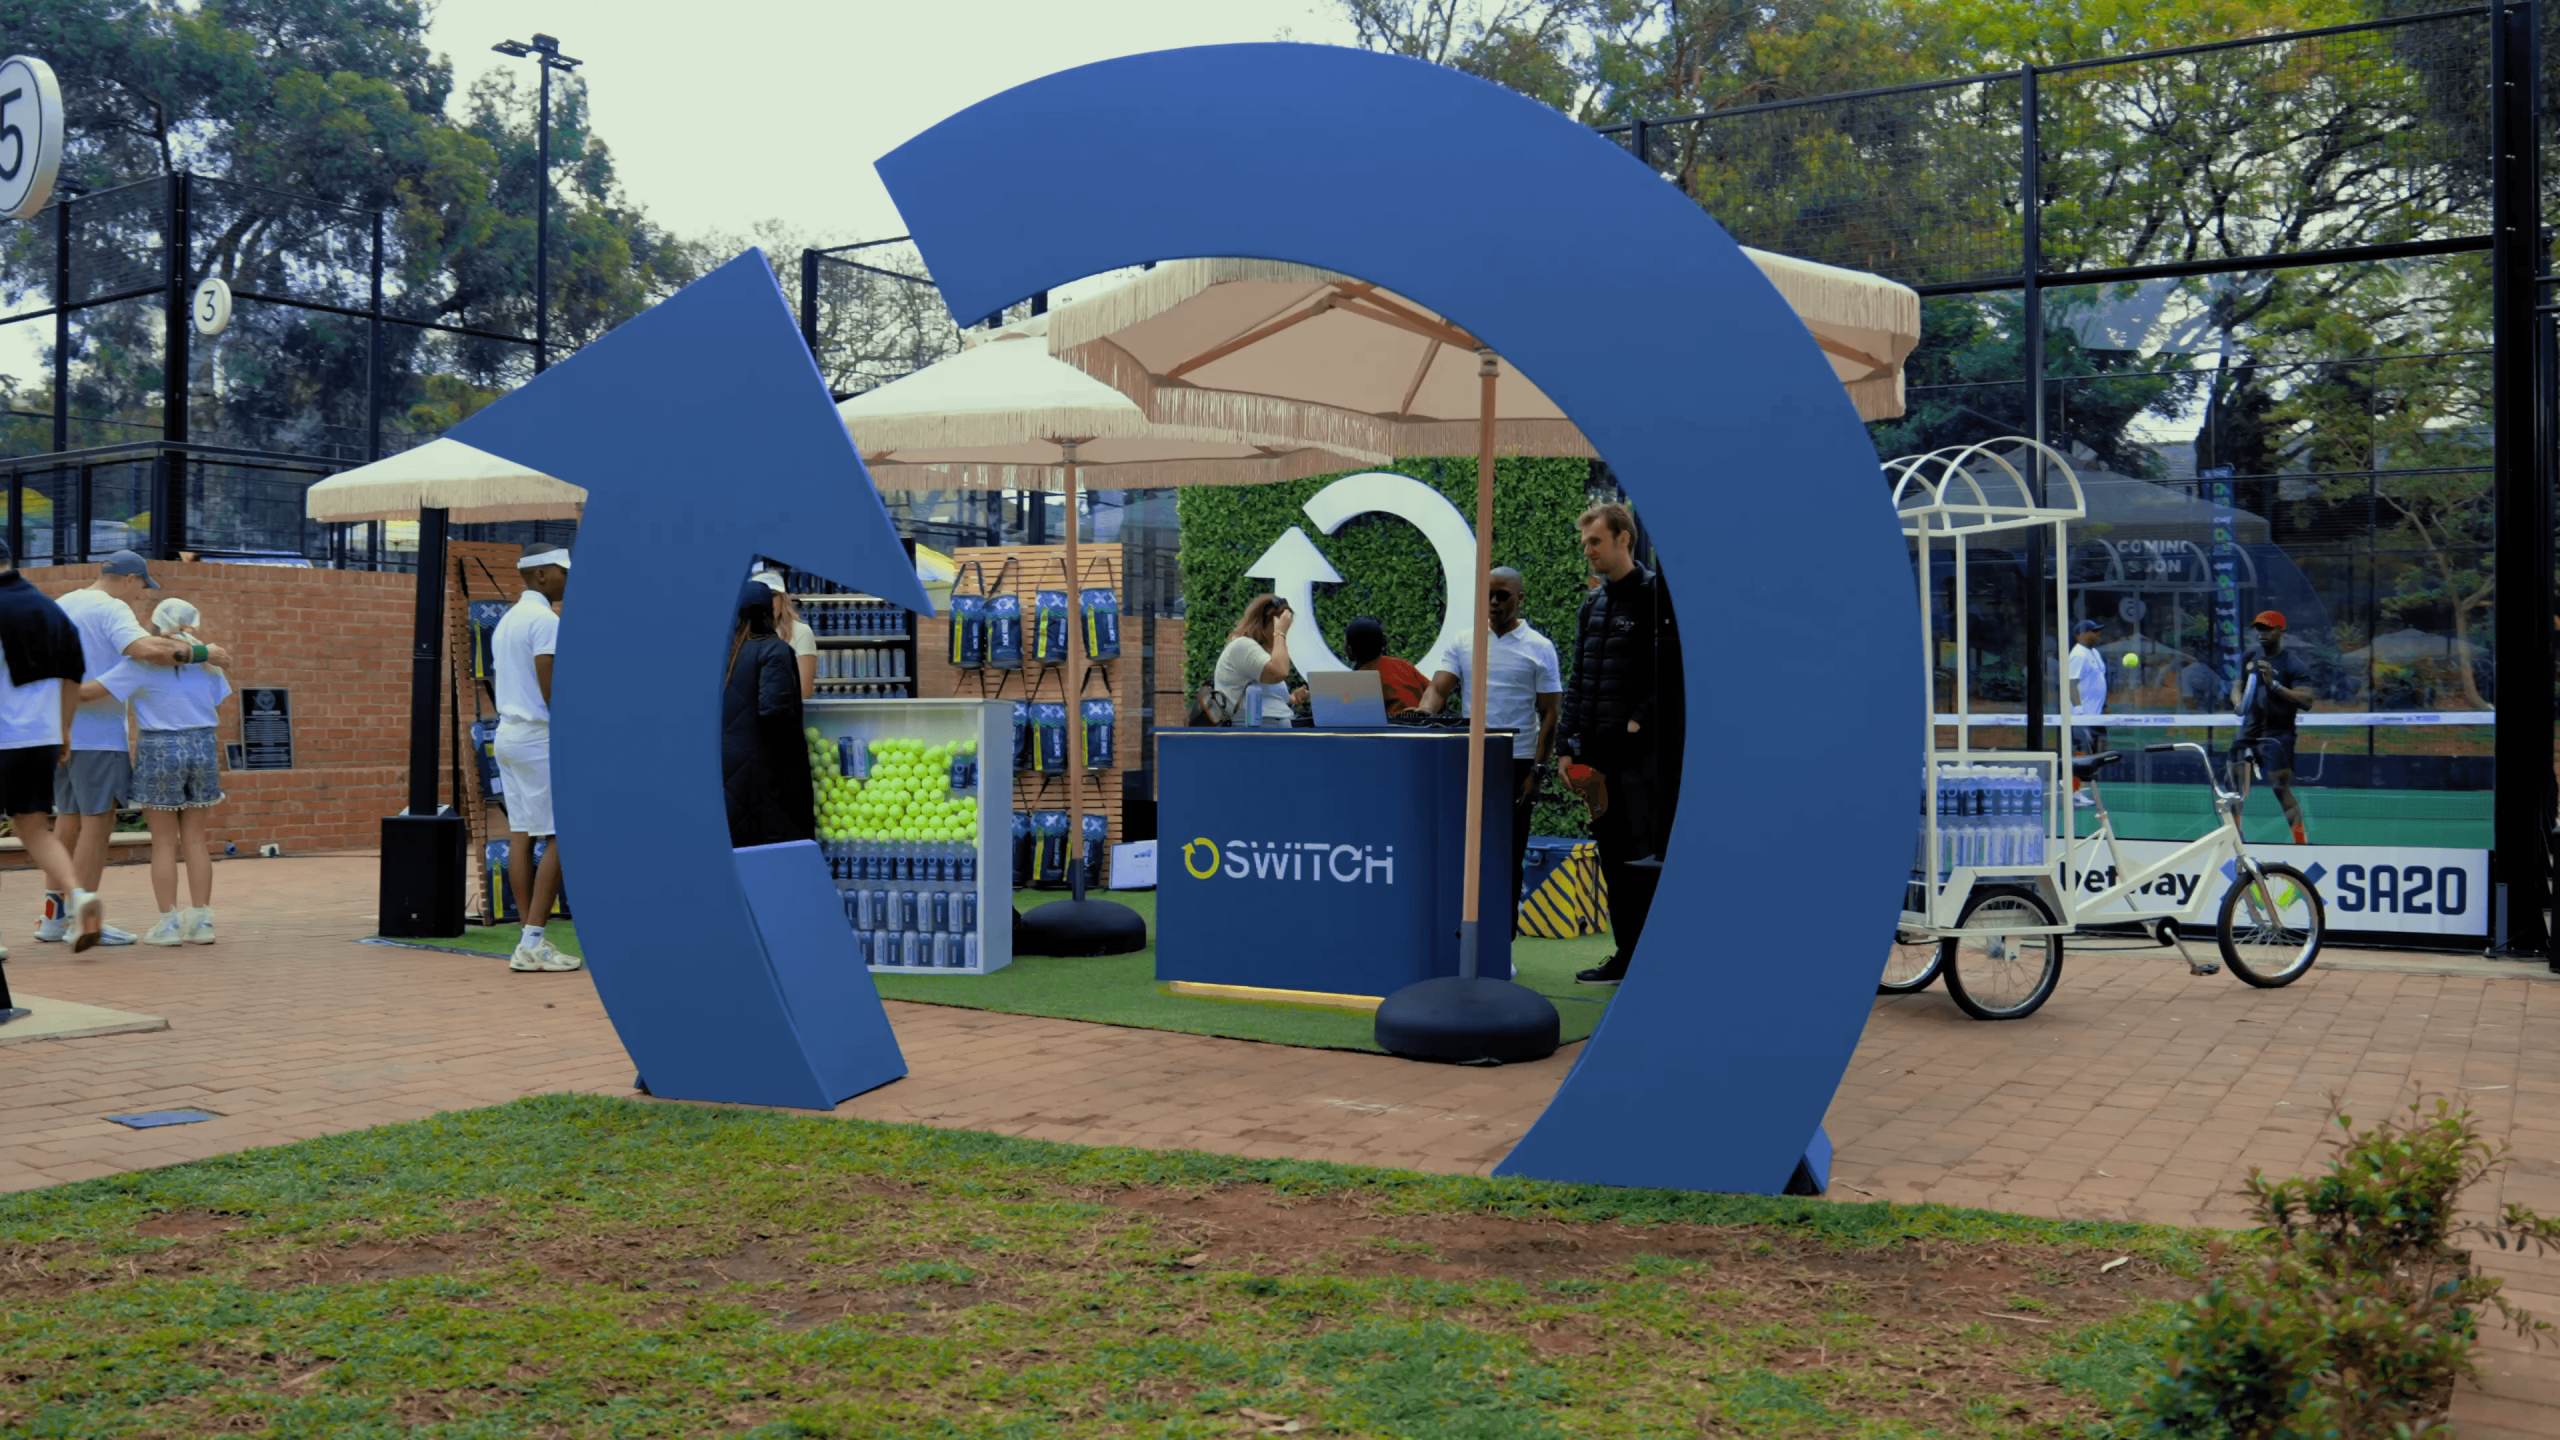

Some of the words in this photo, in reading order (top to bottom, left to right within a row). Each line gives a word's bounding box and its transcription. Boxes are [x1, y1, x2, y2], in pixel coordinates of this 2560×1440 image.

[0, 87, 23, 181] 5
[201, 290, 216, 322] 3
[1224, 840, 1393, 884] SWITCH
[2337, 863, 2467, 915] SA20
